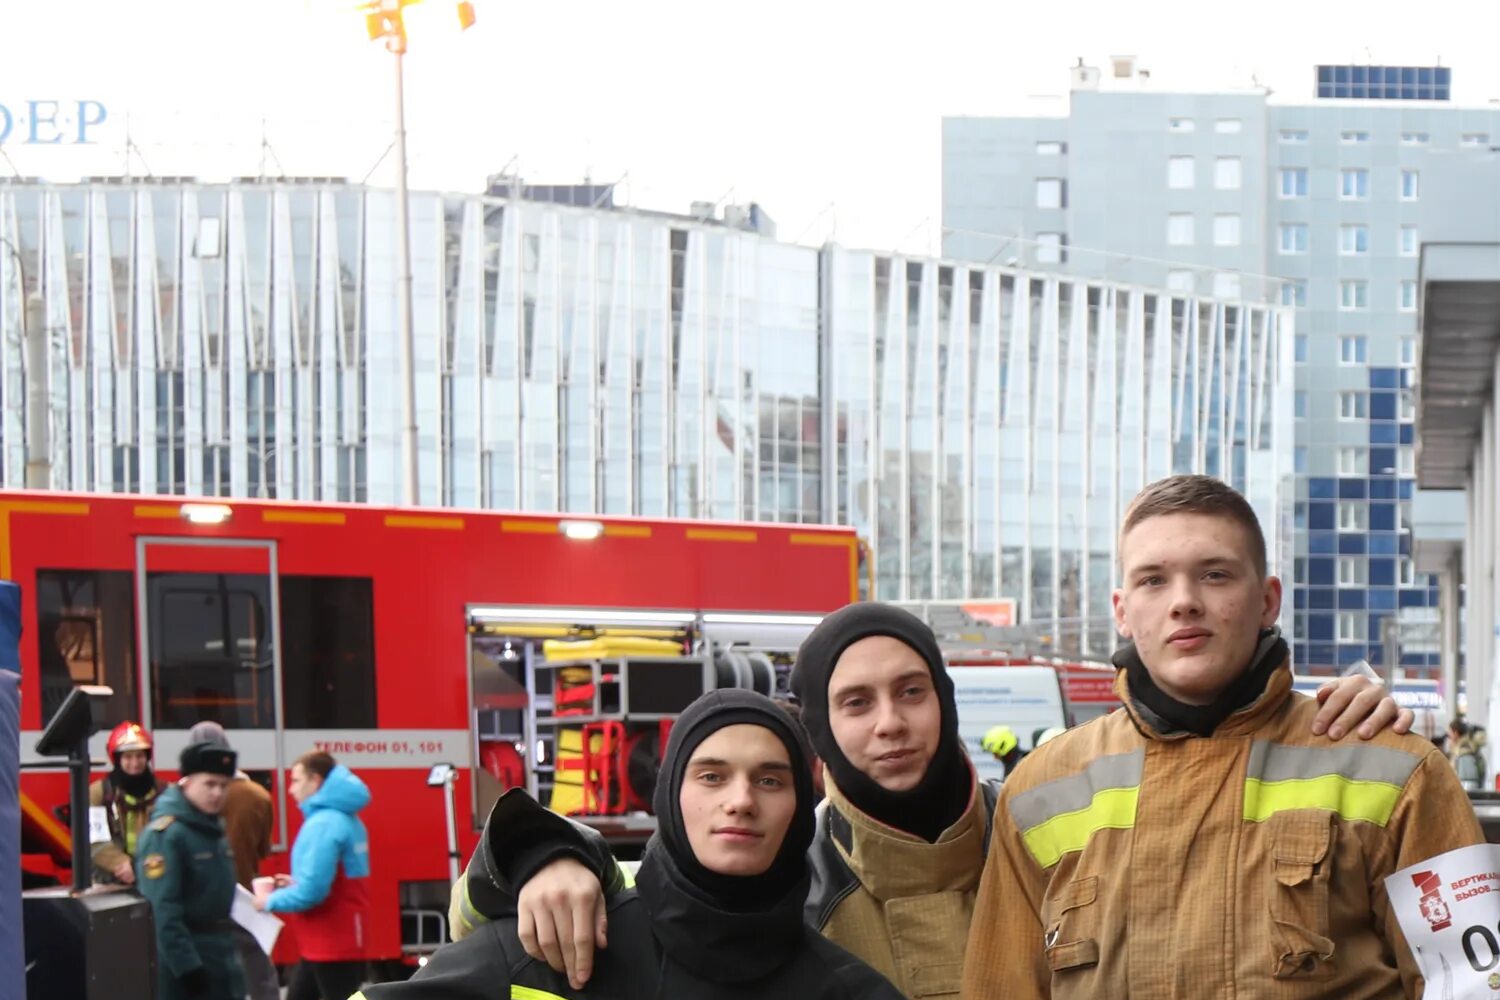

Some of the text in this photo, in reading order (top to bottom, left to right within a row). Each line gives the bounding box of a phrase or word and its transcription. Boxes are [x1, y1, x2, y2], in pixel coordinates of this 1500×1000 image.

[314, 741, 387, 753] ТЕЛЕФОН
[419, 741, 443, 753] 101
[1455, 884, 1491, 902] ВЫЗОВ
